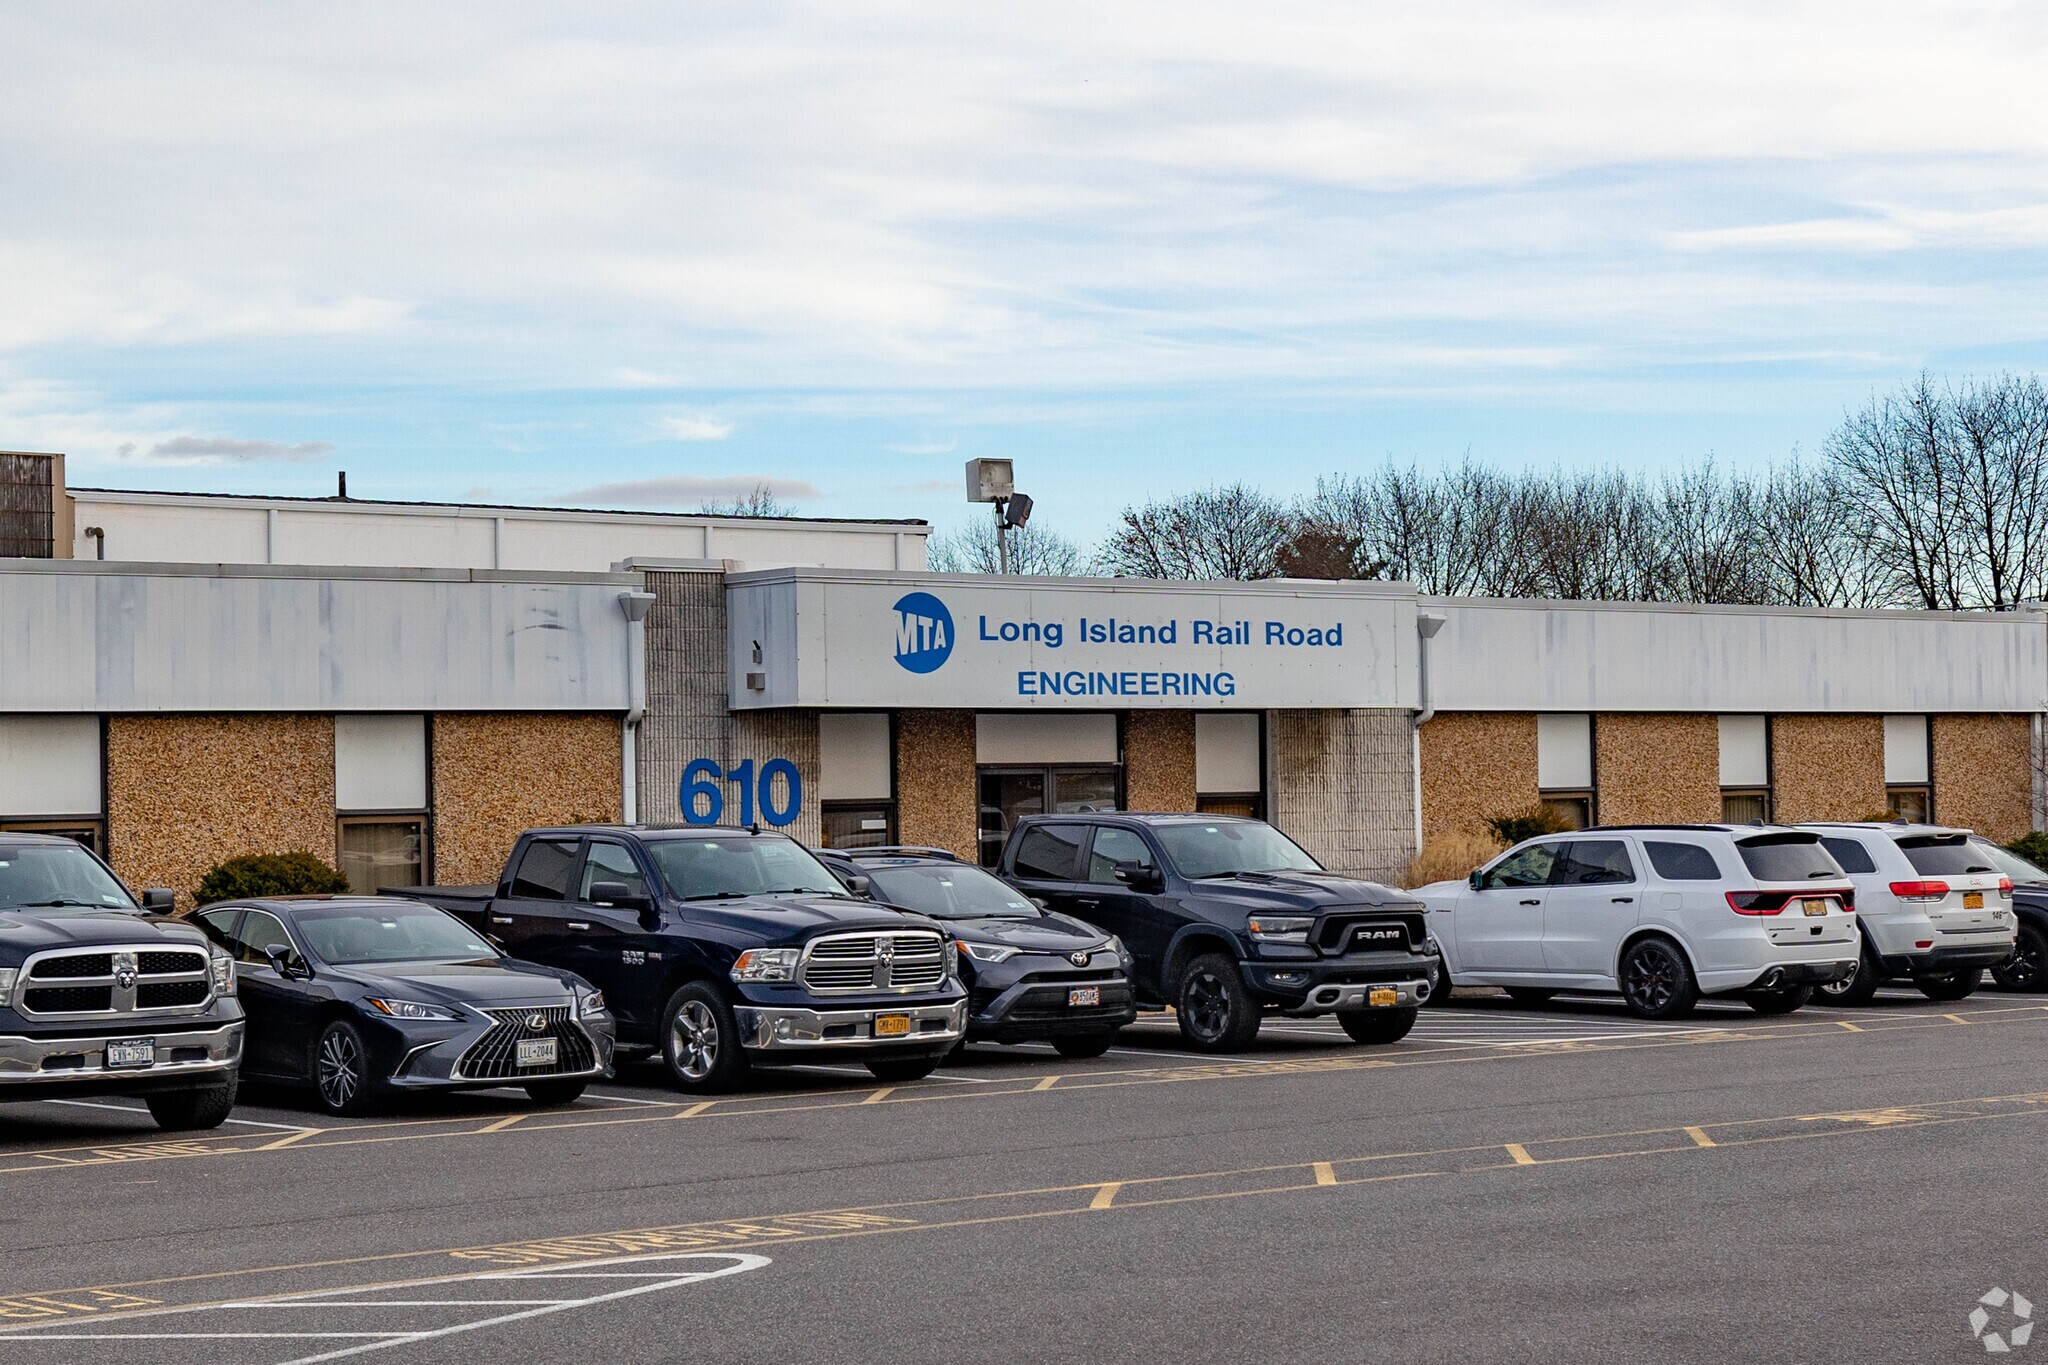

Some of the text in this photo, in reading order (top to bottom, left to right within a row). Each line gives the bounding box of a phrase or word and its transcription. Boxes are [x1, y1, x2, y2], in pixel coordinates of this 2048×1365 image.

[893, 609, 947, 656] MTA
[979, 615, 1344, 649] Long Island Rail Road
[1018, 671, 1236, 697] ENGINEERING
[679, 757, 803, 828] 610
[1356, 930, 1400, 940] RAM
[622, 950, 645, 958] RAM
[622, 957, 645, 965] 1500
